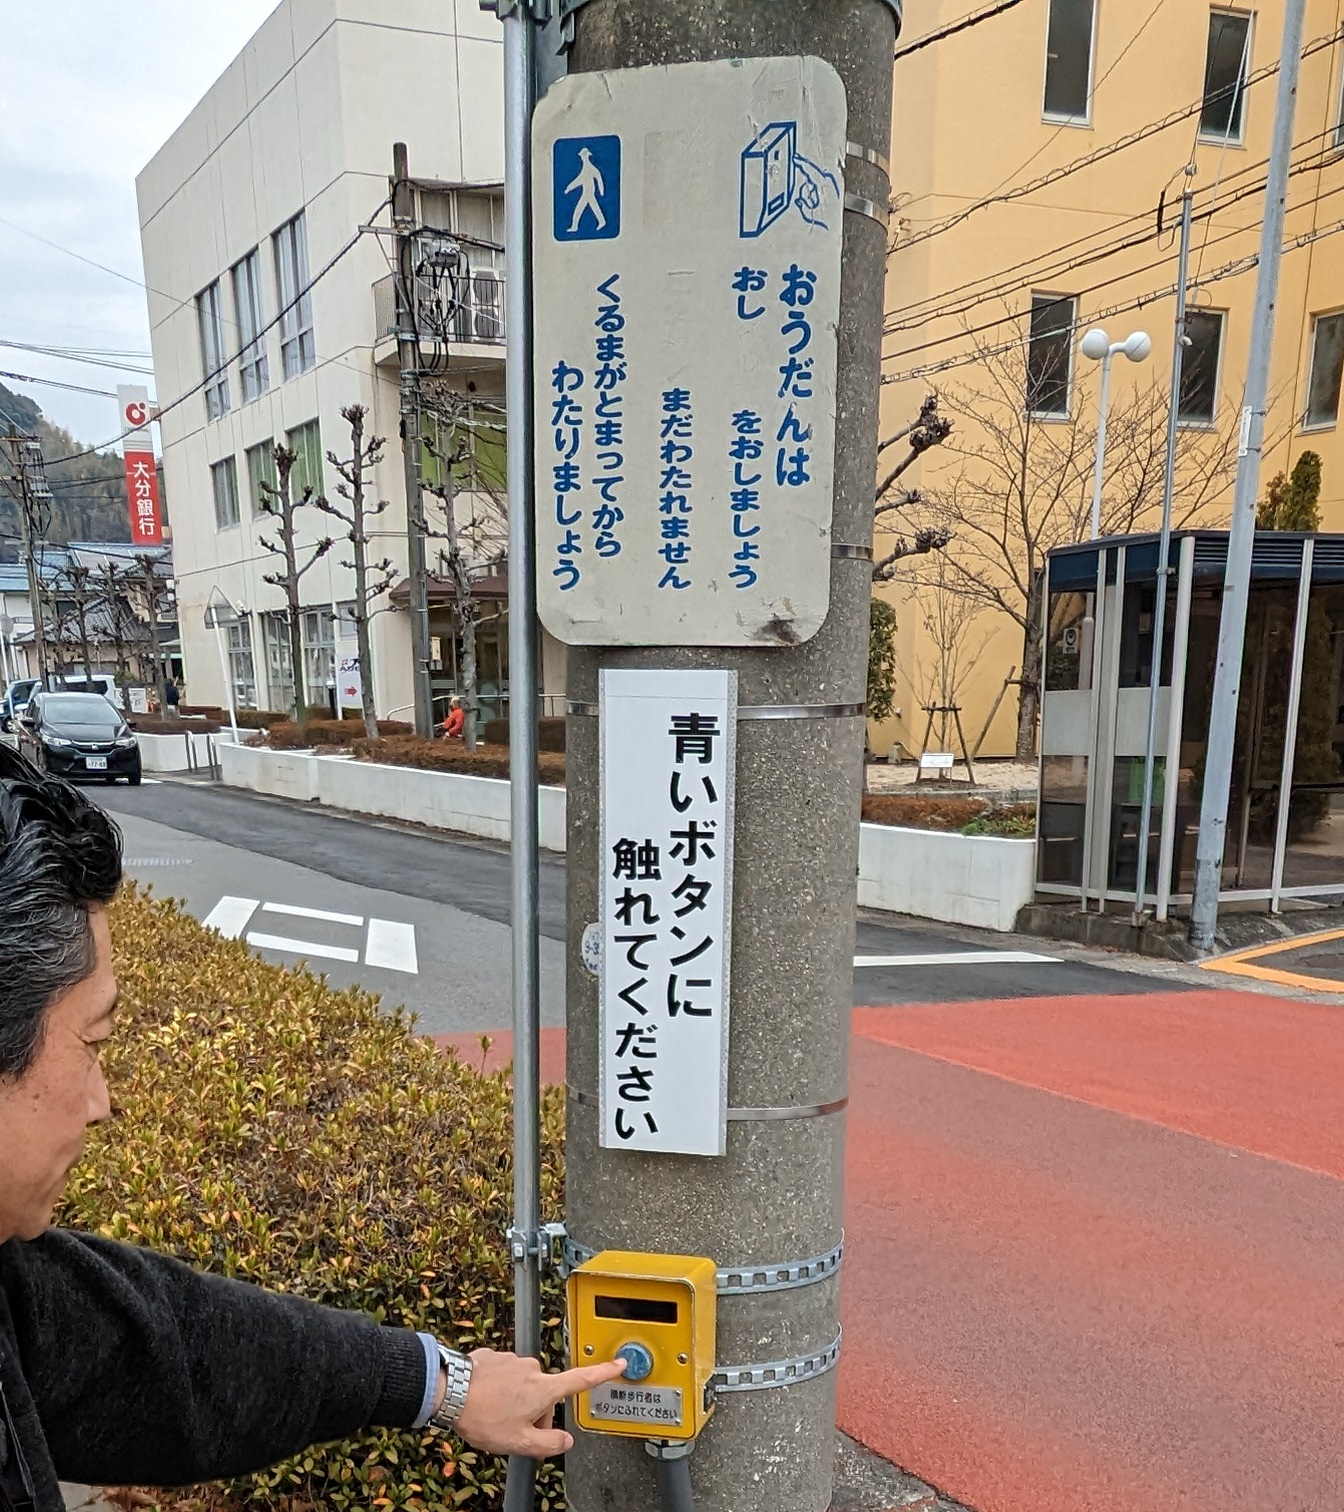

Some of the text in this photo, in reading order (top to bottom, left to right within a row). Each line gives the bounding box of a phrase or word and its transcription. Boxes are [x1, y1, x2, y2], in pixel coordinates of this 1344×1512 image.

[551, 361, 584, 591] わたりましょう
[593, 273, 627, 558] くるまがとまってから
[658, 387, 693, 589] まだわたれません
[729, 267, 767, 589] おし をおしましょう
[774, 264, 817, 487] おうだんは
[132, 461, 155, 536] 大分銀行
[667, 712, 720, 1018] 青いボタンに
[612, 837, 661, 1140] 触れてください
[610, 1388, 662, 1404] 横断歩行者は
